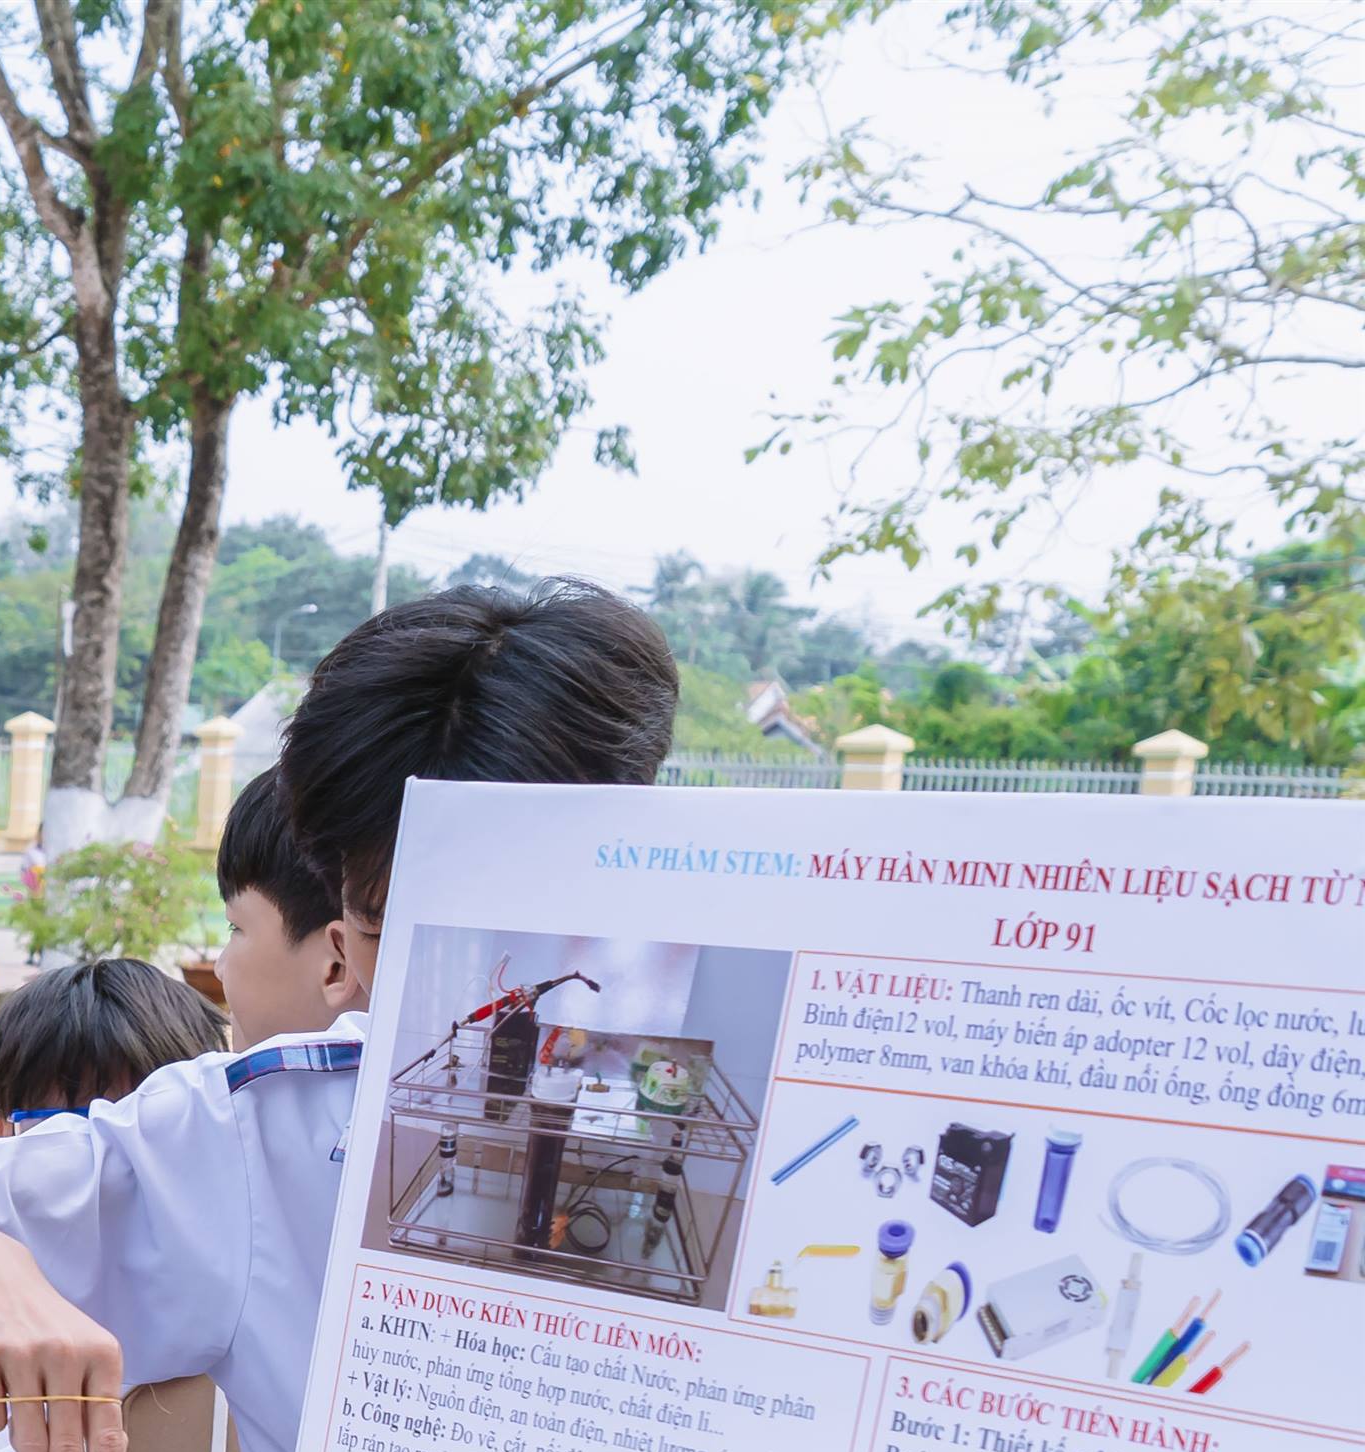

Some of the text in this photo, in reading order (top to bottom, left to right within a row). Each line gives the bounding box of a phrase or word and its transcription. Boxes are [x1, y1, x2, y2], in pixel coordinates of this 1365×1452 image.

[724, 850, 802, 877] STEM:
[941, 860, 1014, 889] MINI
[1063, 922, 1096, 953] 91
[811, 969, 826, 991] 1.
[961, 980, 1022, 1007] Thanh
[1027, 993, 1060, 1011] ren
[794, 1038, 876, 1066] polymer
[879, 1044, 932, 1072] 8mm,
[941, 1057, 974, 1075] van
[924, 1014, 958, 1040] vol,
[1093, 1029, 1176, 1061] adopter
[1182, 1036, 1208, 1061] 12
[1215, 1040, 1254, 1069] vol,
